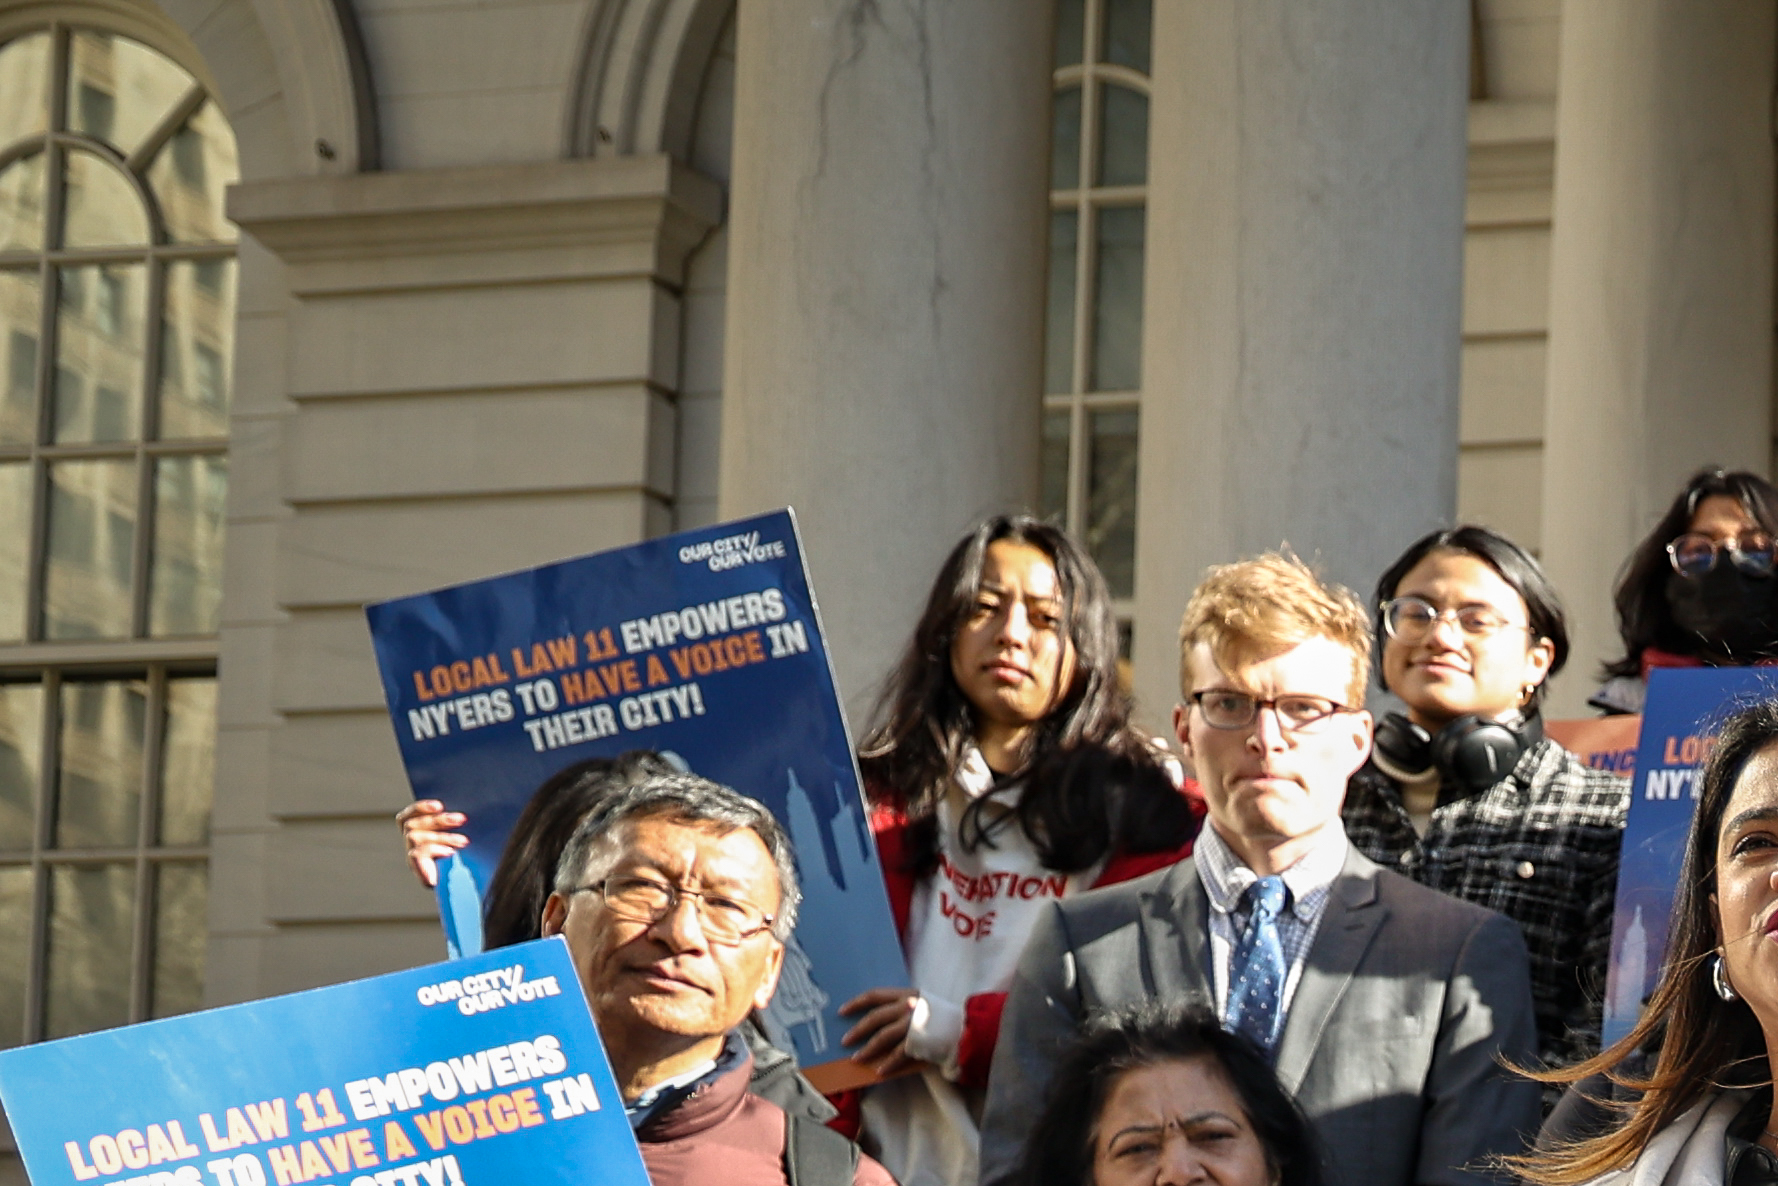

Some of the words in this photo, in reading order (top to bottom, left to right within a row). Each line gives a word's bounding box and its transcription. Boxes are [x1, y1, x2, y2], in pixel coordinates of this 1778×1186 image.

[679, 542, 713, 563] OUR
[708, 551, 745, 572] OUR
[741, 537, 787, 563] VOTE
[413, 653, 509, 701] LOCAL
[512, 636, 579, 679] LAW
[583, 627, 620, 662] 11
[620, 588, 787, 654] EMPOWERS
[408, 689, 515, 742] NY'ERS
[515, 678, 559, 715] TO
[561, 660, 643, 705] HAVE
[646, 654, 670, 688] A
[670, 631, 767, 679] VOICE
[765, 621, 811, 659] IN
[524, 707, 620, 753] THEIR
[619, 683, 706, 732] CITY!
[417, 980, 464, 1006] OUR
[458, 990, 506, 1016] OUR
[500, 972, 562, 1004] VOTE
[64, 1119, 200, 1181] LOCAL
[198, 1097, 289, 1152] LAW
[295, 1087, 347, 1132] 11
[344, 1034, 568, 1121] EMPOWERS
[267, 1128, 380, 1186] HAVE
[384, 1120, 418, 1162] A
[413, 1087, 545, 1150] VOICE
[542, 1072, 601, 1121] IN
